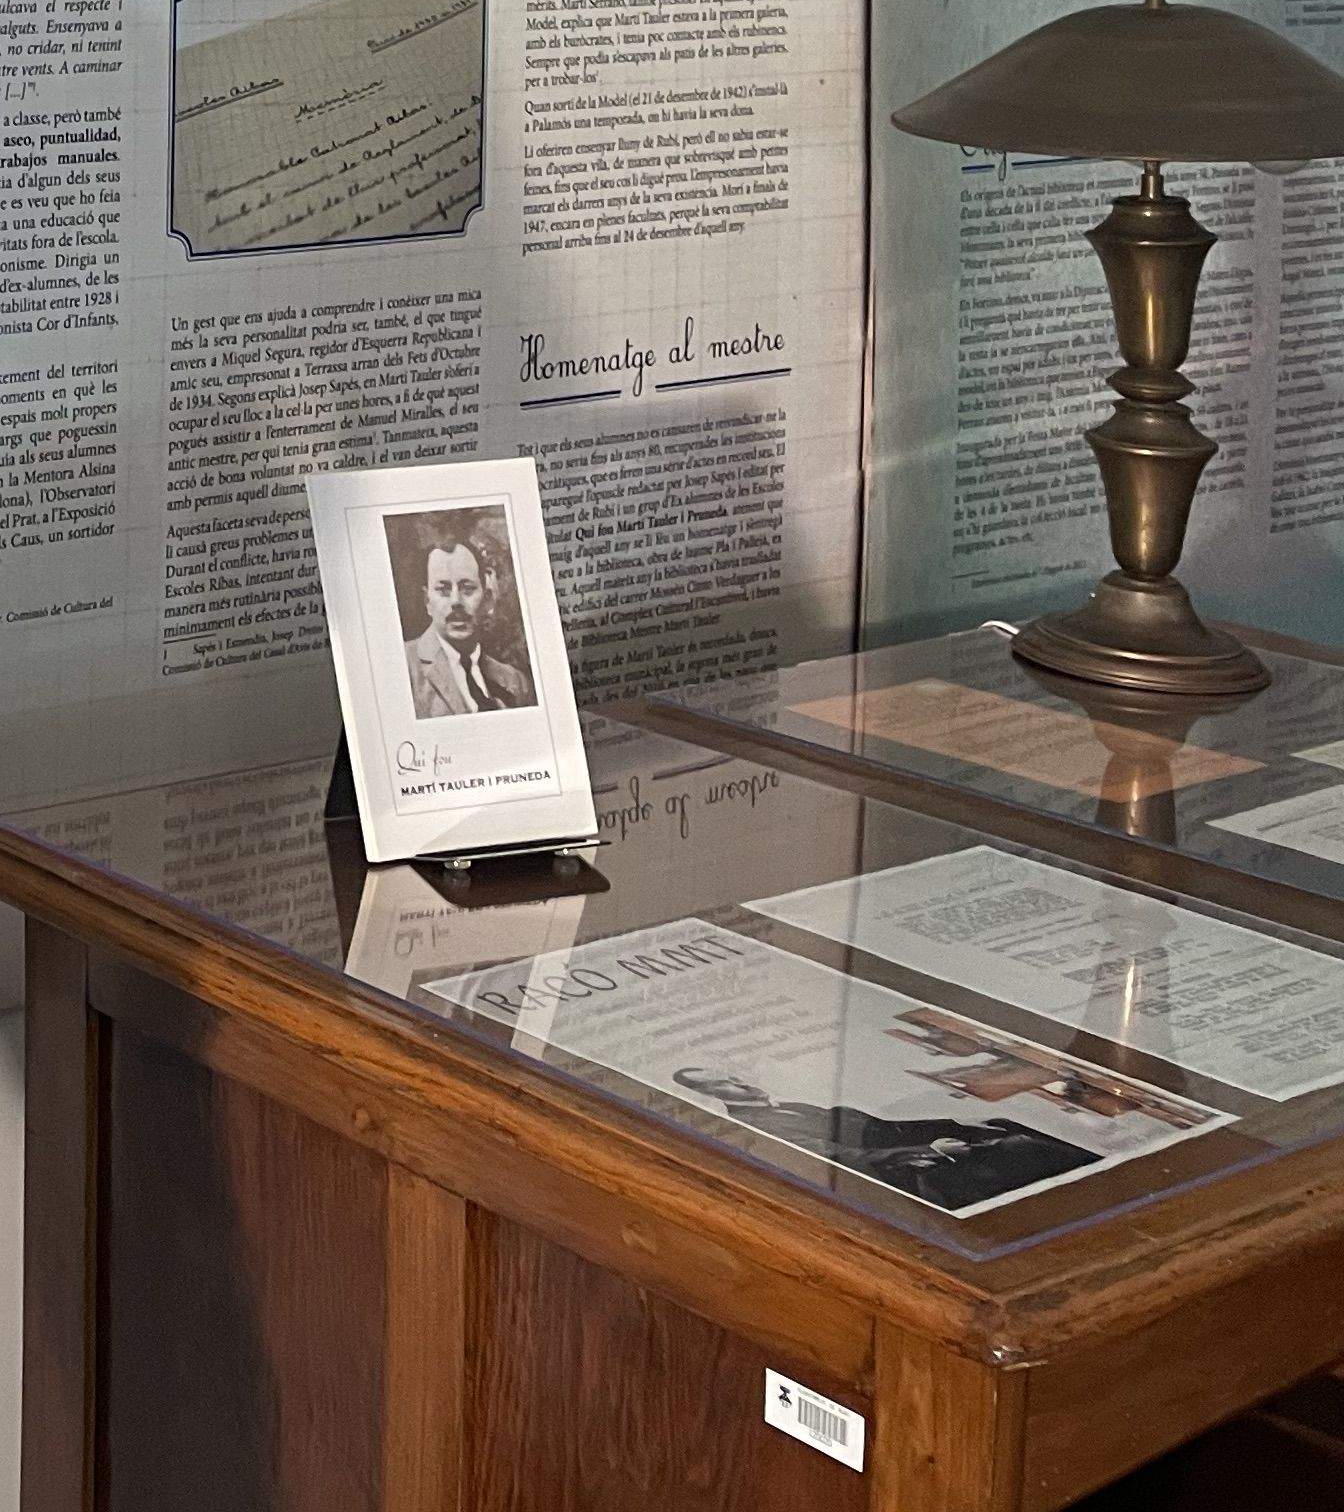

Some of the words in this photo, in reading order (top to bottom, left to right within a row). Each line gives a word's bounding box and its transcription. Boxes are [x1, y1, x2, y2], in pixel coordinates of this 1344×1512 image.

[520, 333, 656, 397] Homenatge
[668, 316, 696, 363] al
[708, 322, 785, 359] mestre
[401, 781, 437, 797] MARTÍ
[439, 777, 486, 793] TAULER
[496, 769, 552, 787] PRUNEDA
[617, 935, 744, 980] MMT
